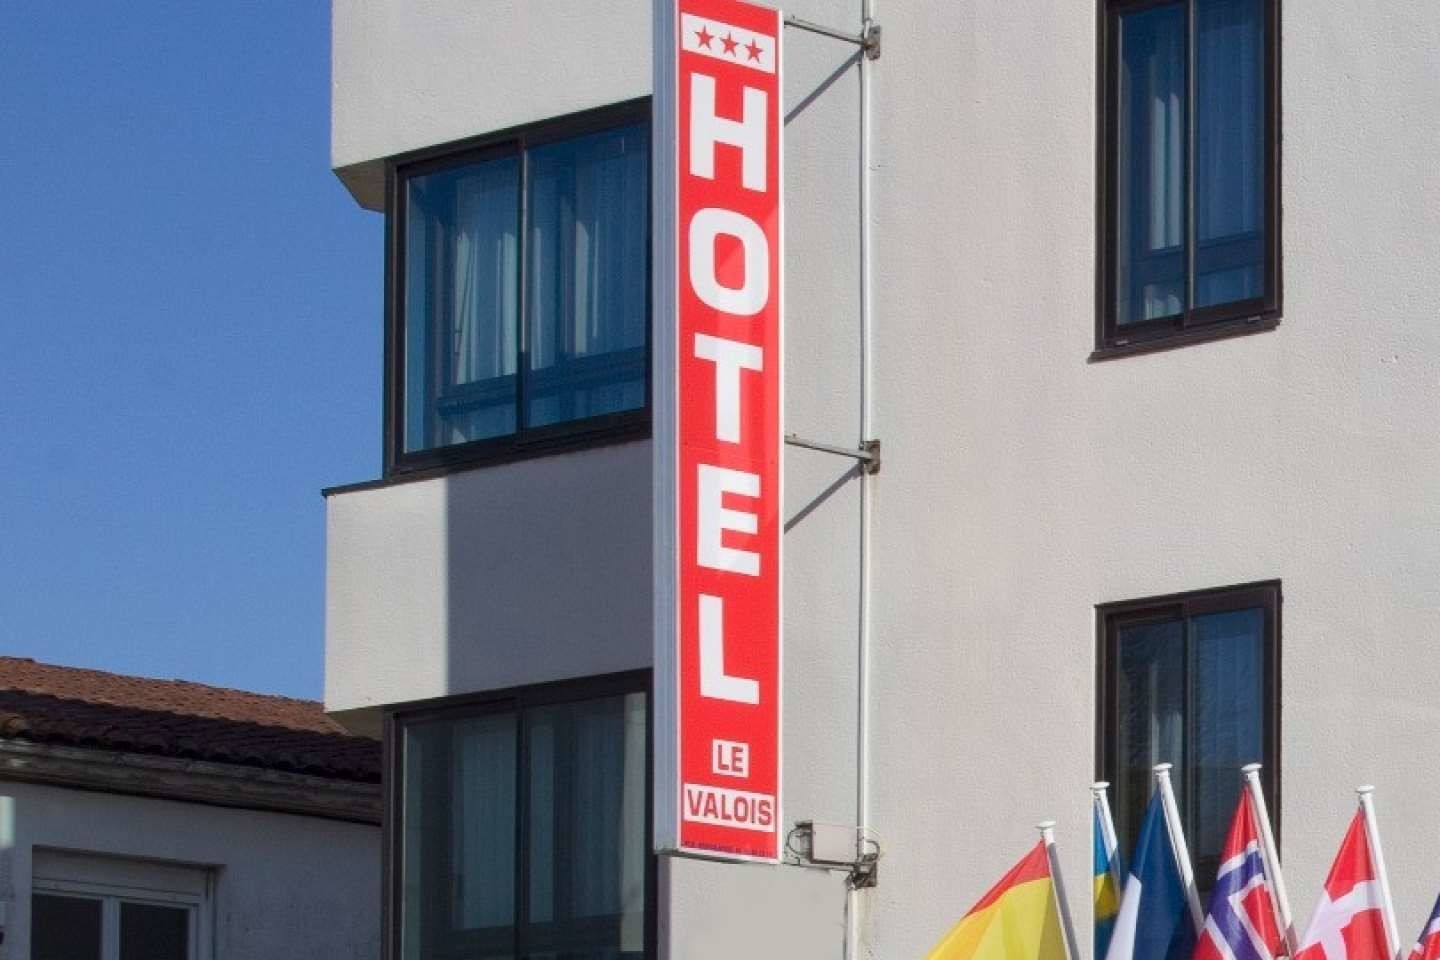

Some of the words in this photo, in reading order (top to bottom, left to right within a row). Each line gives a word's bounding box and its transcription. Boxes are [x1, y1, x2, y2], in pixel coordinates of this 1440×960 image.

[688, 72, 770, 705] HOTEL
[717, 744, 744, 773] LE
[687, 789, 772, 826] VALOIS
